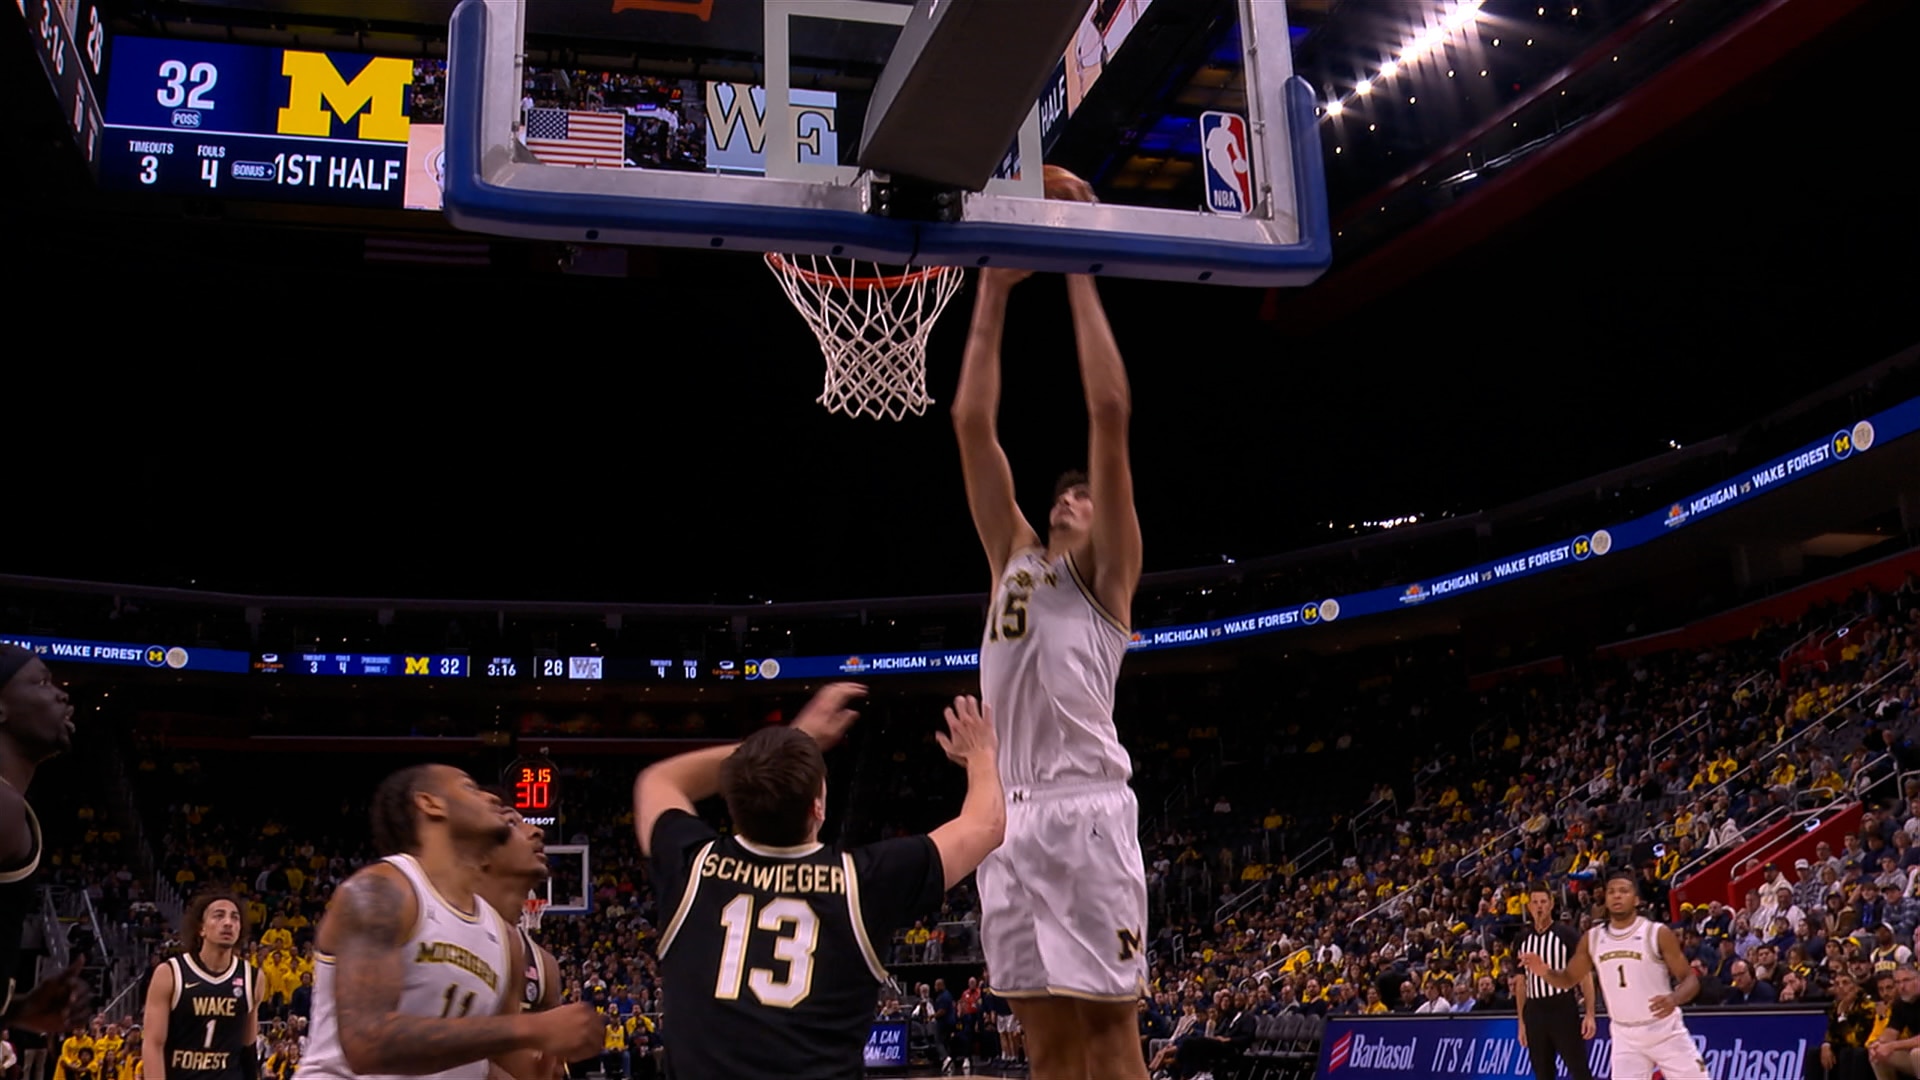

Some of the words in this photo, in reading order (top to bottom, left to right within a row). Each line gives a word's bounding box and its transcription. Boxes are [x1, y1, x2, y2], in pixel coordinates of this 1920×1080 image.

[157, 60, 218, 110] 32
[277, 50, 414, 142] M
[1041, 75, 1065, 137] HALF
[173, 113, 199, 125] POSS
[129, 140, 174, 155] TIMEOUTS
[197, 145, 226, 158] FOULS
[140, 155, 159, 184] 3
[201, 159, 219, 188] 4
[275, 153, 322, 187] 1ST
[328, 156, 401, 191] HALF
[1214, 189, 1237, 208] NBA
[1690, 484, 1737, 515] MICHIGAN
[1752, 463, 1786, 488] WAKE
[1787, 444, 1830, 475] FOREST
[1432, 572, 1479, 596] MICHIGAN
[1494, 559, 1526, 578] WAKE
[1528, 545, 1570, 569] FOREST
[1154, 628, 1208, 645] MICHIGAN
[1224, 619, 1256, 635] WAKE
[1258, 610, 1300, 629] FOREST
[52, 643, 91, 657] WAKE
[93, 647, 143, 661] FOREST
[872, 656, 927, 670] MICHIGAN
[944, 653, 979, 667] WAKE
[310, 661, 318, 674] 3
[339, 661, 347, 674] 4
[404, 656, 430, 675] M
[440, 658, 460, 675] 32
[487, 663, 517, 677] 3:16
[657, 666, 665, 679] 4
[685, 666, 697, 679] 10
[522, 768, 551, 783] 3:15
[515, 782, 548, 808] 30
[701, 853, 846, 895] SCHWIEGER
[714, 893, 820, 1009] 13
[1617, 964, 1627, 988] 1
[192, 996, 237, 1016] WAKE
[204, 1019, 217, 1048] 1
[869, 1030, 878, 1044] A
[880, 1030, 901, 1044] CAN
[171, 1049, 230, 1070] FOREST
[1350, 1034, 1417, 1070] Barbasol
[1431, 1038, 1463, 1072] IT'S
[1461, 1038, 1477, 1073] A
[1478, 1038, 1515, 1075] CAN
